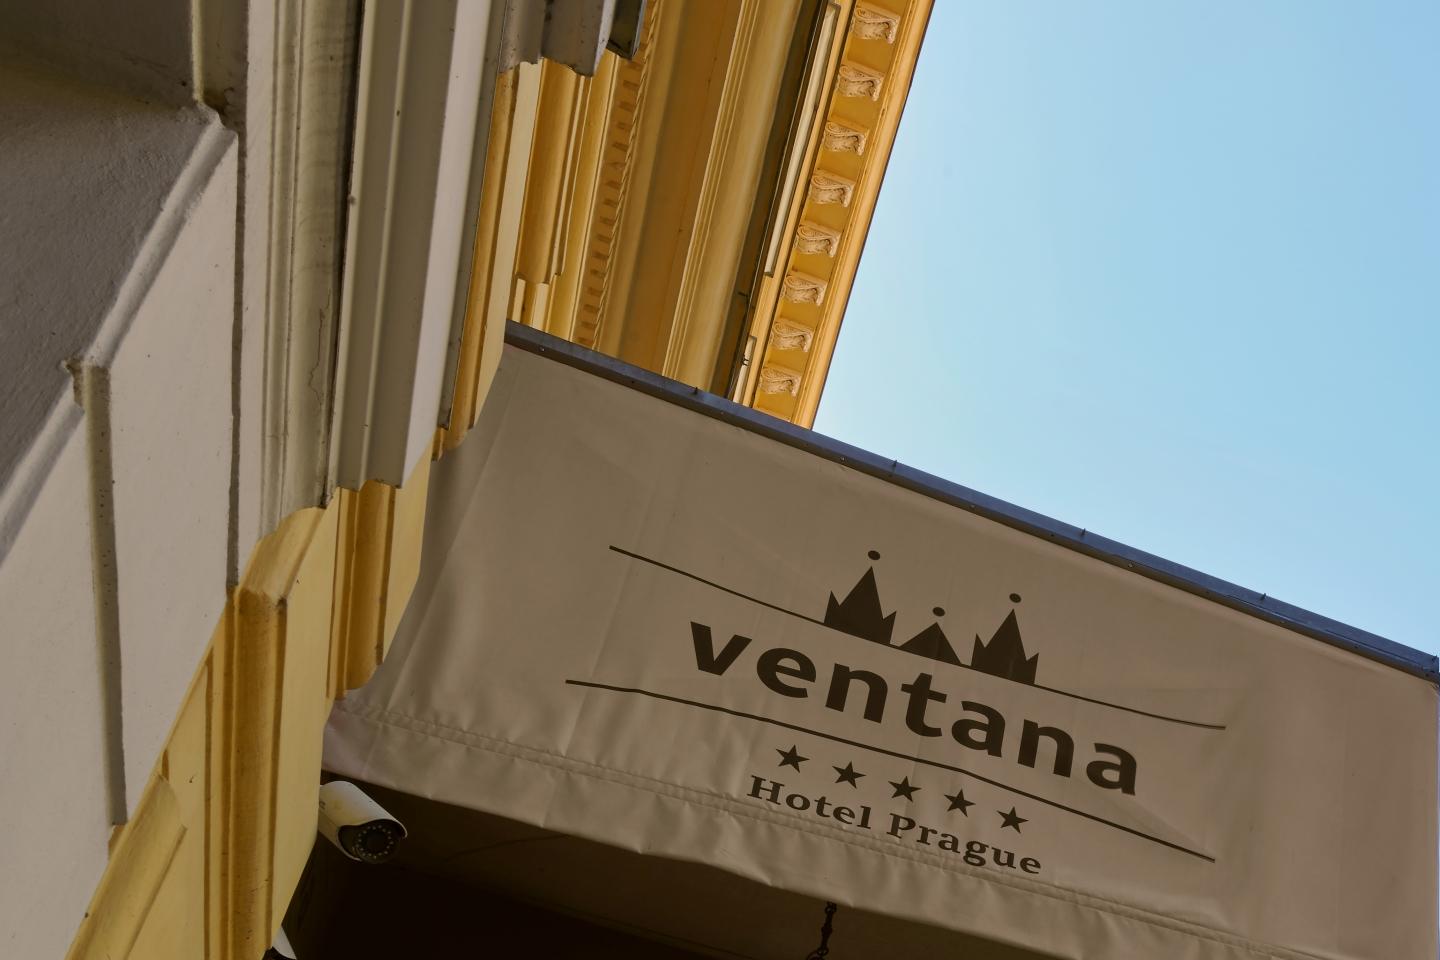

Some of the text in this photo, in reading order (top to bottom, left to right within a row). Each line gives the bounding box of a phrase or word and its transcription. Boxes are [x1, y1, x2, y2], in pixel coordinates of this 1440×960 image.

[690, 621, 1138, 795] ventana
[747, 774, 1041, 875] Hotel Prague
